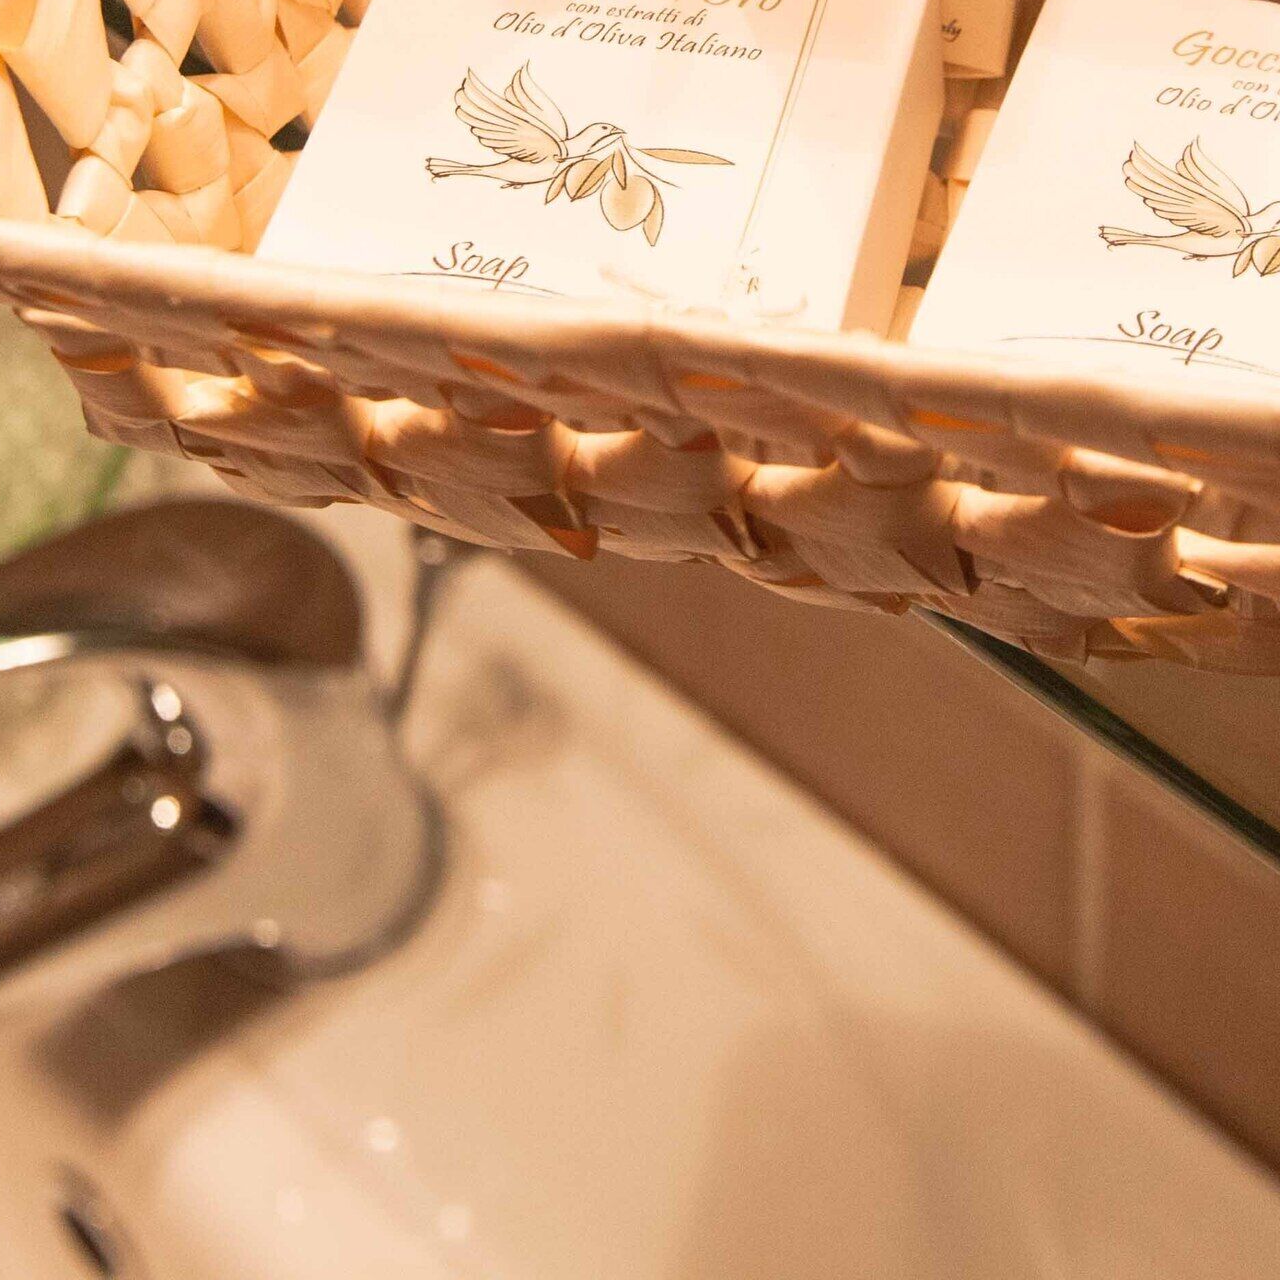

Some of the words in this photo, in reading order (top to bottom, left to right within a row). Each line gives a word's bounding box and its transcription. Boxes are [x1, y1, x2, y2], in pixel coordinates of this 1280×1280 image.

[565, 0, 600, 16] con
[605, 5, 683, 25] estratti
[682, 7, 708, 27] di
[492, 11, 547, 36] Olio
[550, 16, 647, 48] d'Oliva
[655, 31, 764, 62] Italiano
[1155, 86, 1213, 113] Olio
[1231, 78, 1270, 95] con
[432, 241, 531, 291] Soap
[1116, 309, 1225, 367] Soap
